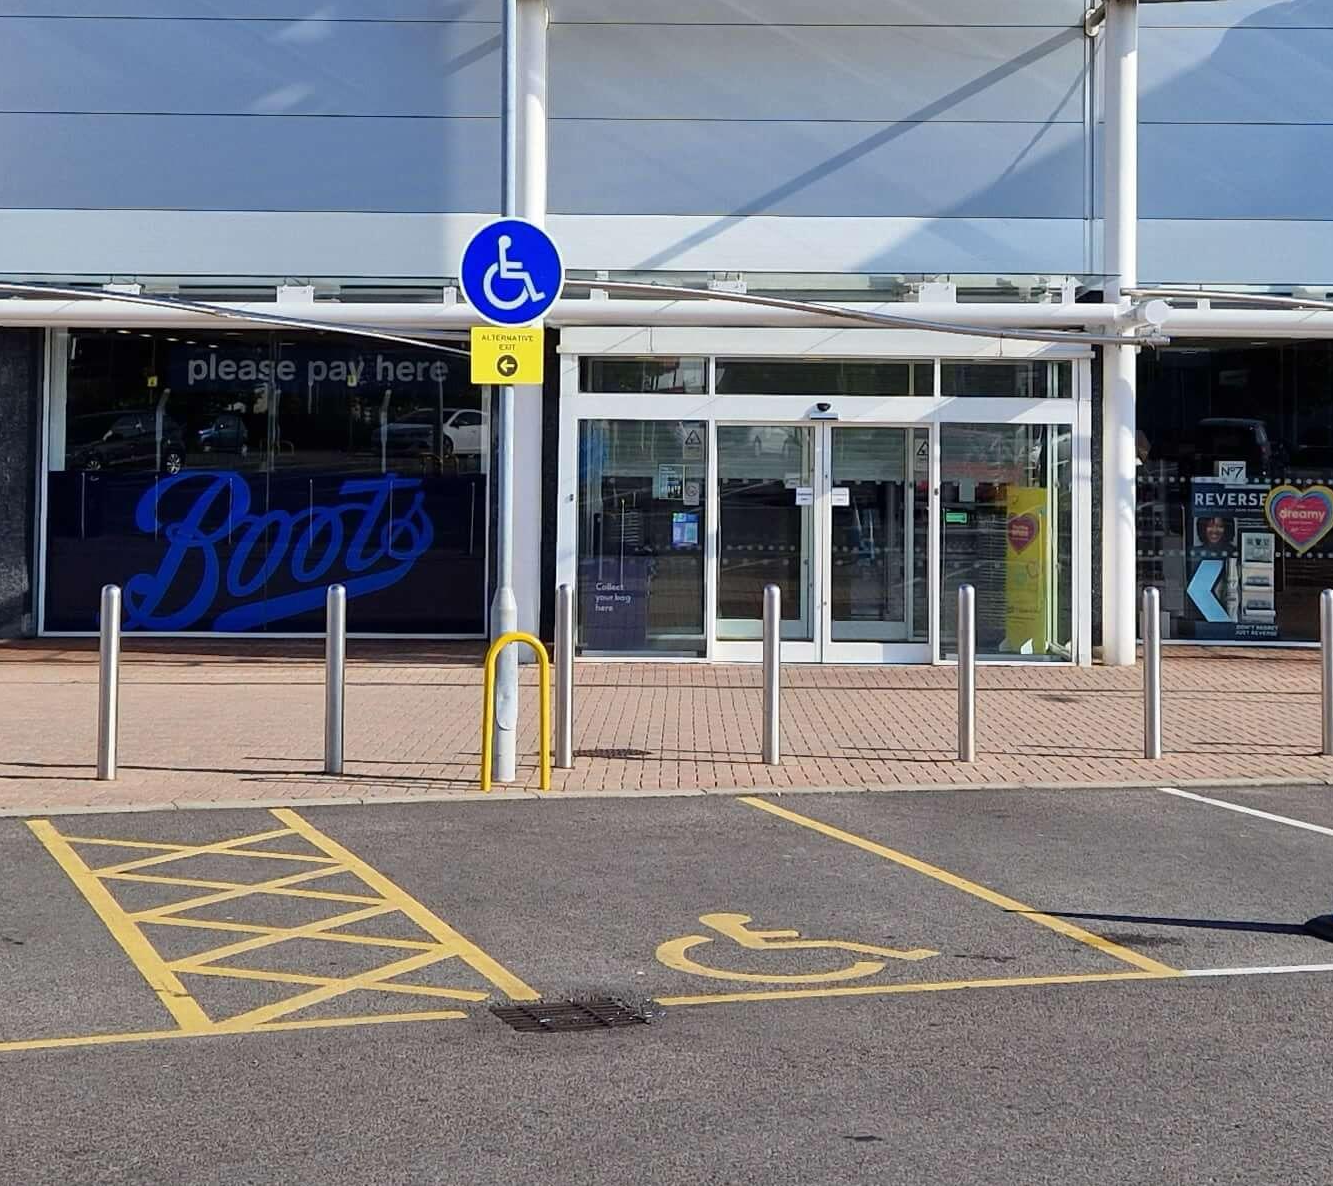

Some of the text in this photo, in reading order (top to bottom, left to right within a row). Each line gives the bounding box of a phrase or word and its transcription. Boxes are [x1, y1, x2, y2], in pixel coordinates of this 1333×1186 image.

[481, 334, 534, 342] ALTERNATIVE
[499, 343, 516, 351] EXIT
[187, 353, 449, 386] please pay here
[1194, 492, 1268, 507] REVERSE
[1279, 507, 1326, 523] dreamy
[99, 469, 434, 632] Boots
[595, 582, 624, 591] Collect
[595, 604, 614, 612] here
